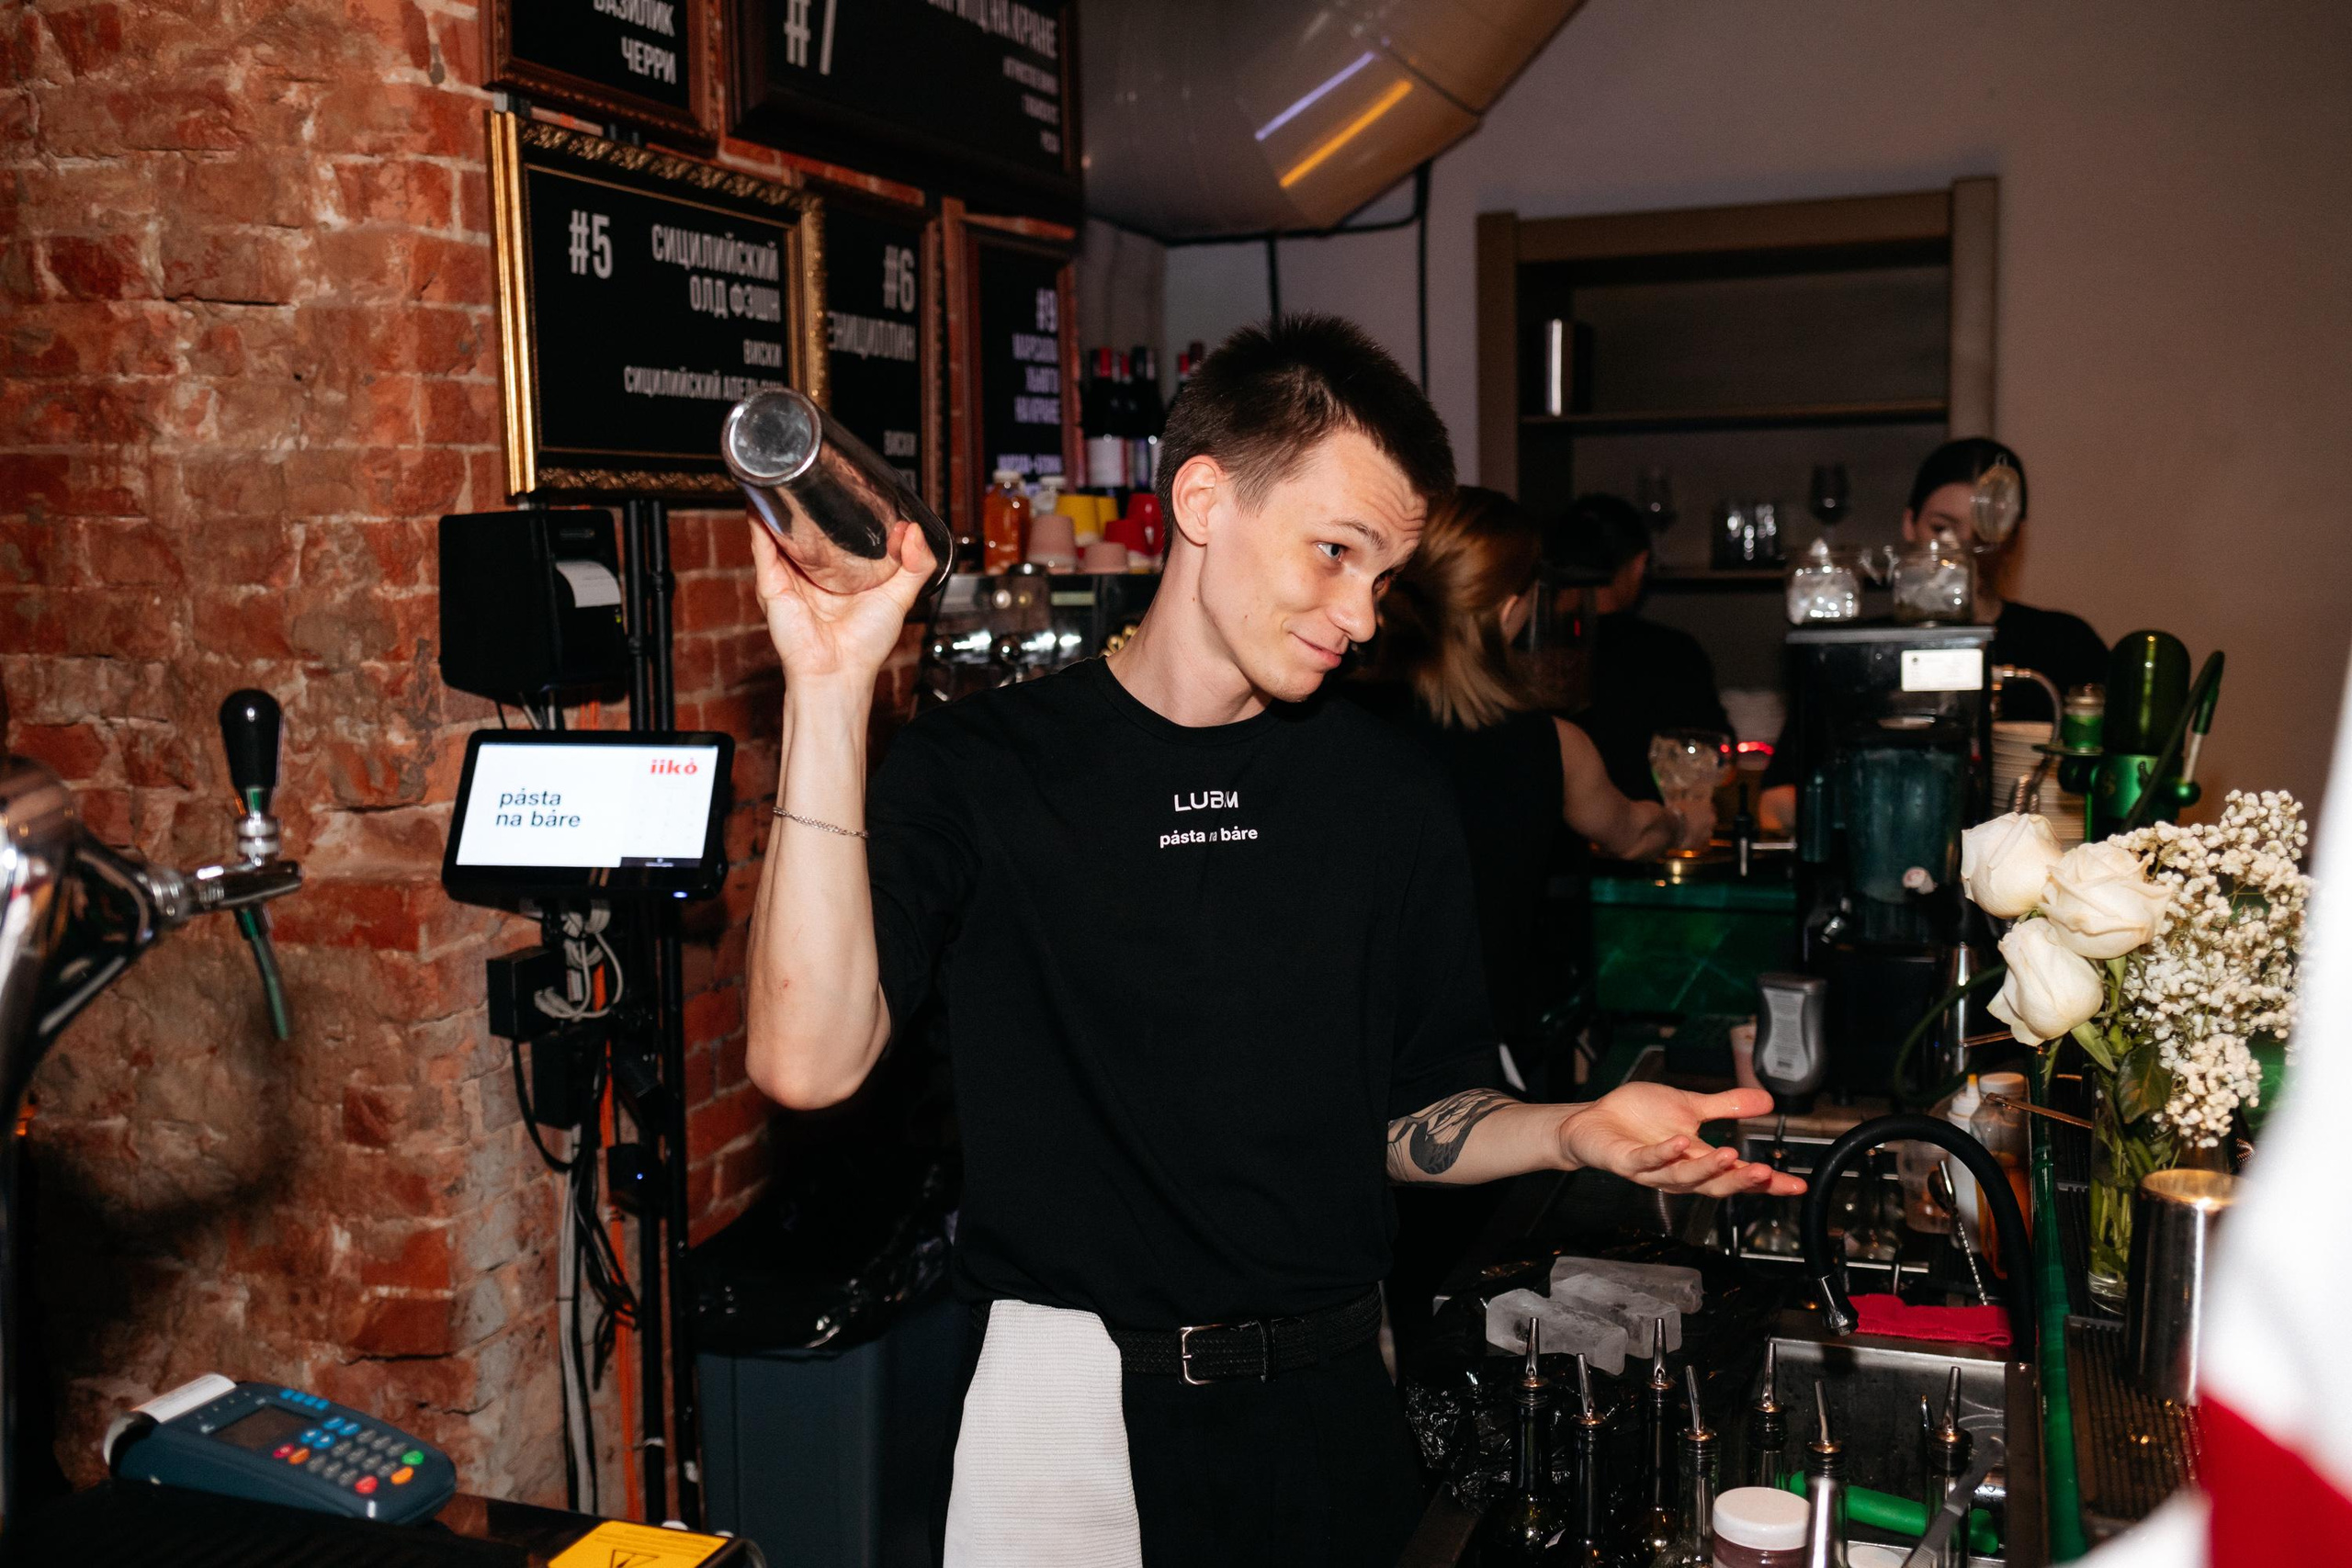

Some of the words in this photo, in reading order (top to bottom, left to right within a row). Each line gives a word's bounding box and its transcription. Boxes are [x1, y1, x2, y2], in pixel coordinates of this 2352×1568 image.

[621, 36, 677, 85] ЧЕРРИ
[569, 209, 613, 279] #5
[651, 223, 780, 281] СИЦИЛИЙСКИЙ
[689, 275, 729, 320] ОЛД
[883, 244, 916, 313] #6
[624, 366, 721, 398] СИЦИЛИЙСКИЙ
[495, 813, 523, 827] na
